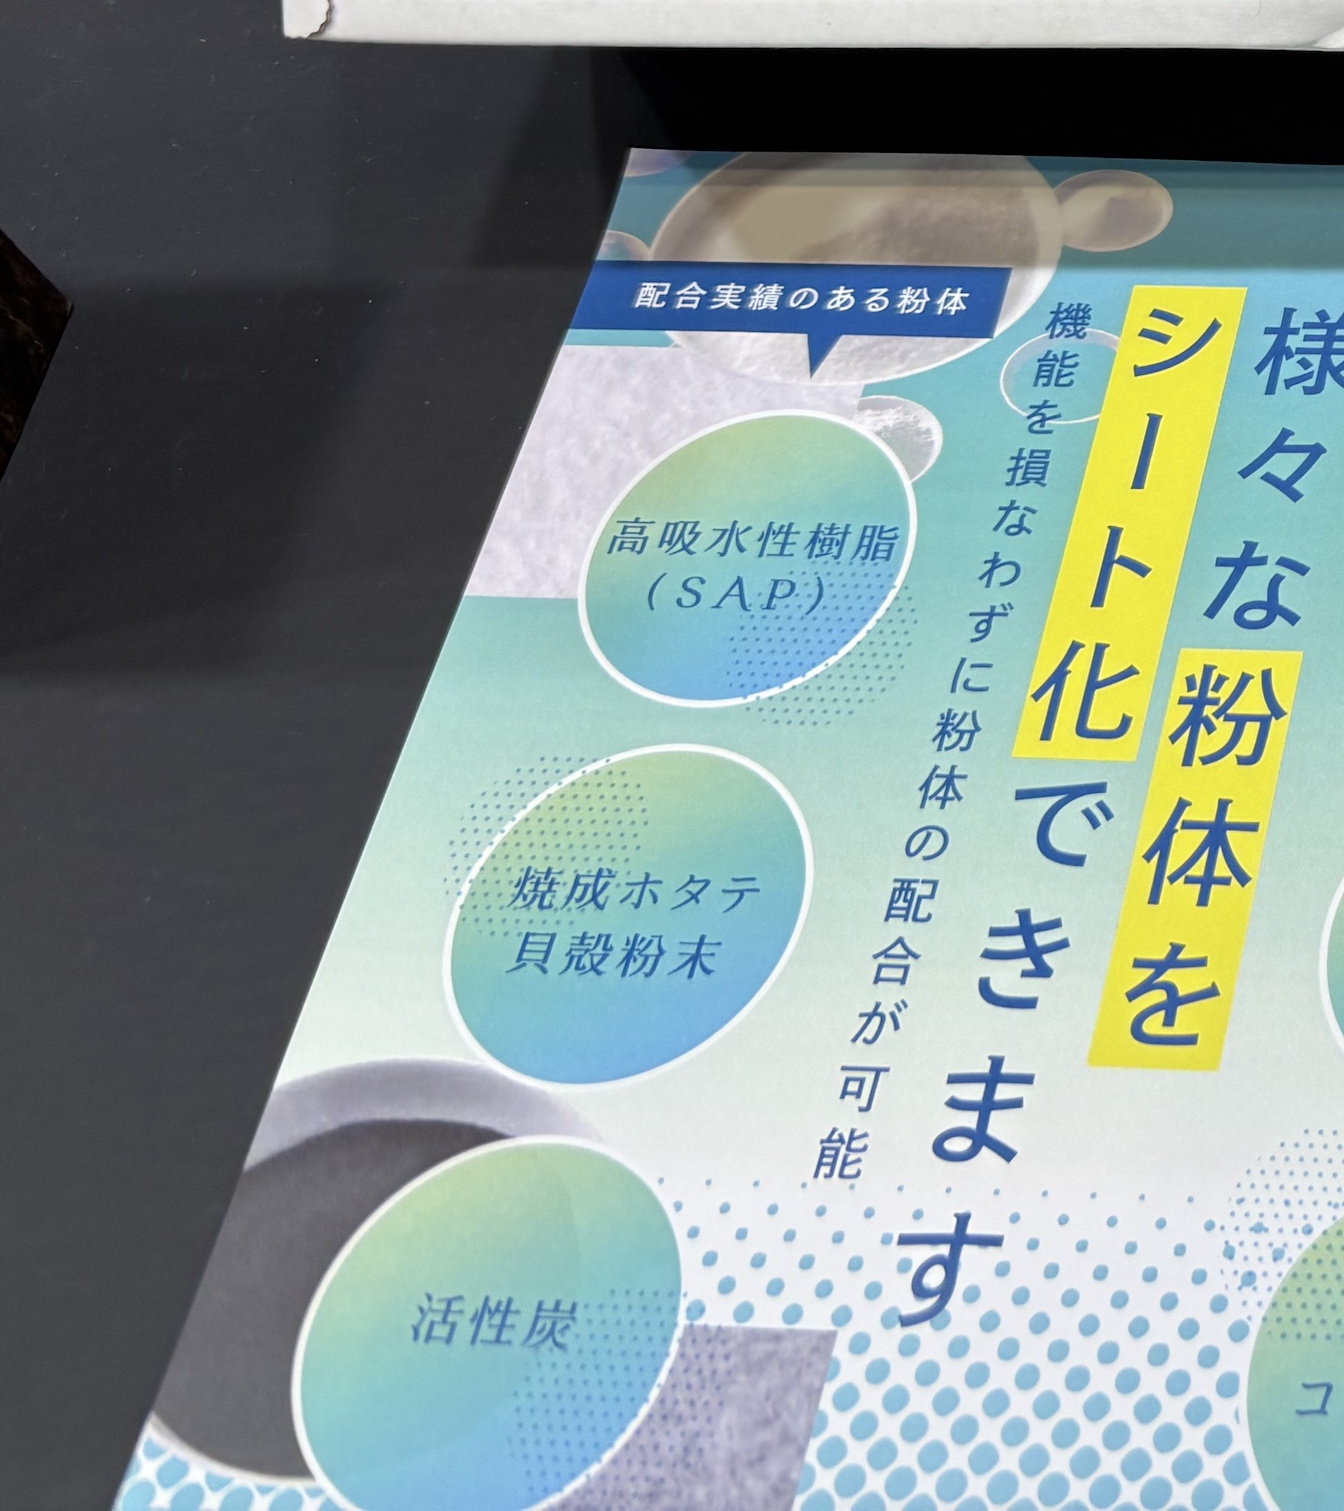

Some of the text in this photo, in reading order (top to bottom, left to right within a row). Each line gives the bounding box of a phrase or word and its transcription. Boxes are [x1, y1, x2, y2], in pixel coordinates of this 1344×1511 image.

[633, 280, 971, 316] 配合実績のある粉体
[606, 516, 900, 563] 高吸水性樹脂
[811, 301, 1092, 1182] 機能を損なわずに粉体の配合が可能
[895, 306, 1223, 1328] シート化できます
[508, 866, 762, 914] 焼成ホタテ
[504, 930, 723, 981] 貝殻粉末
[409, 1291, 580, 1352] 活性炭
